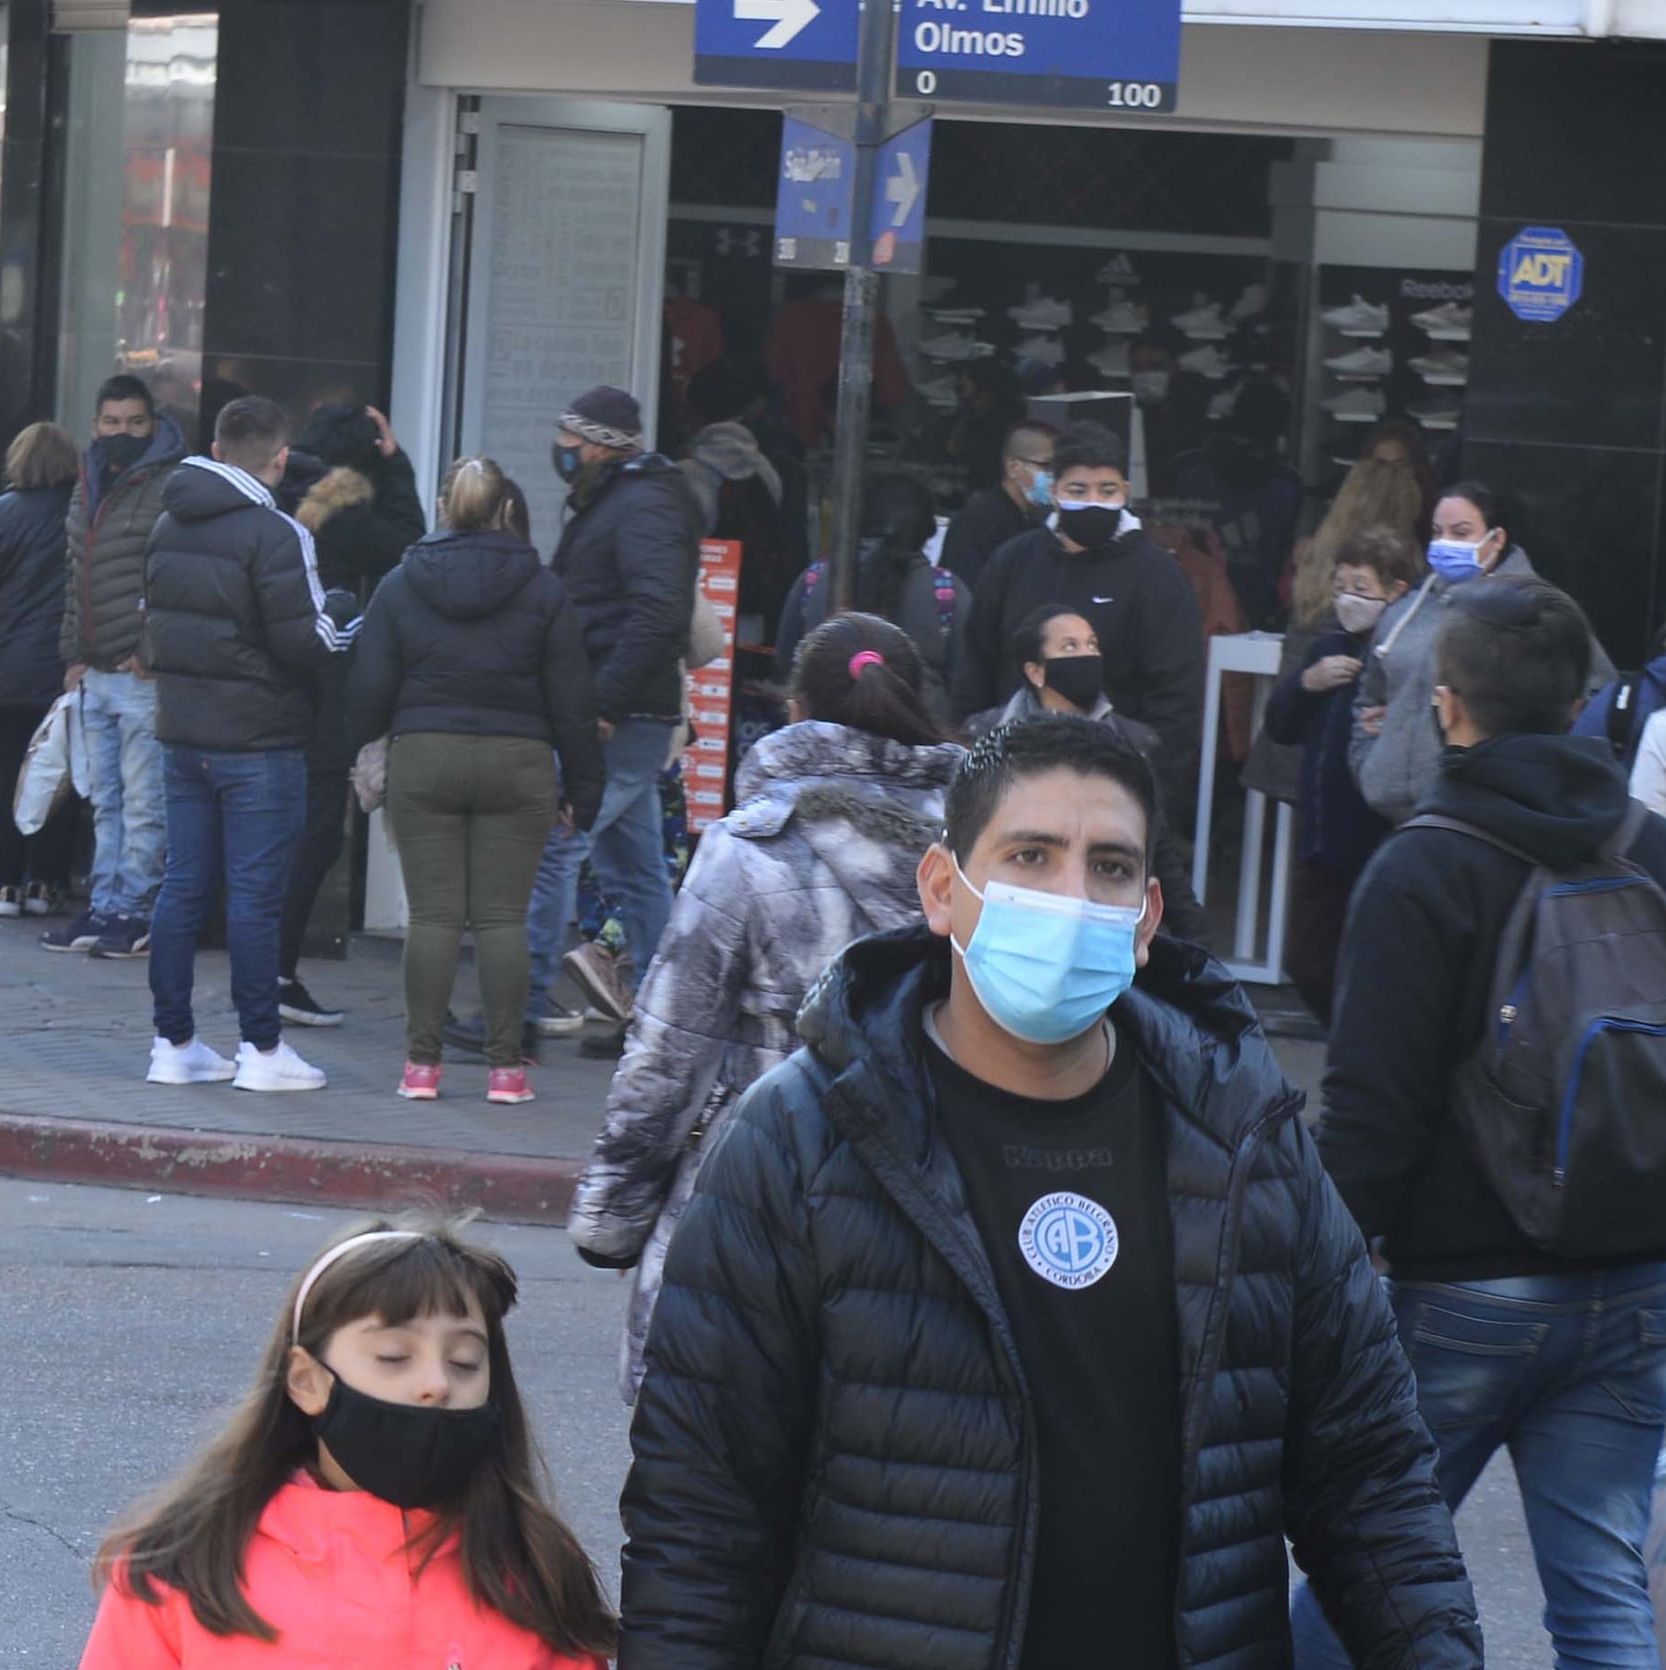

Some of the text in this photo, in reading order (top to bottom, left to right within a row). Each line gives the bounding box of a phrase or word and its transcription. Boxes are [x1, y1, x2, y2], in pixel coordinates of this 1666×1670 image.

[914, 22, 1026, 57] Olmos
[916, 71, 1162, 107] 0 100
[1512, 253, 1571, 288] ADT
